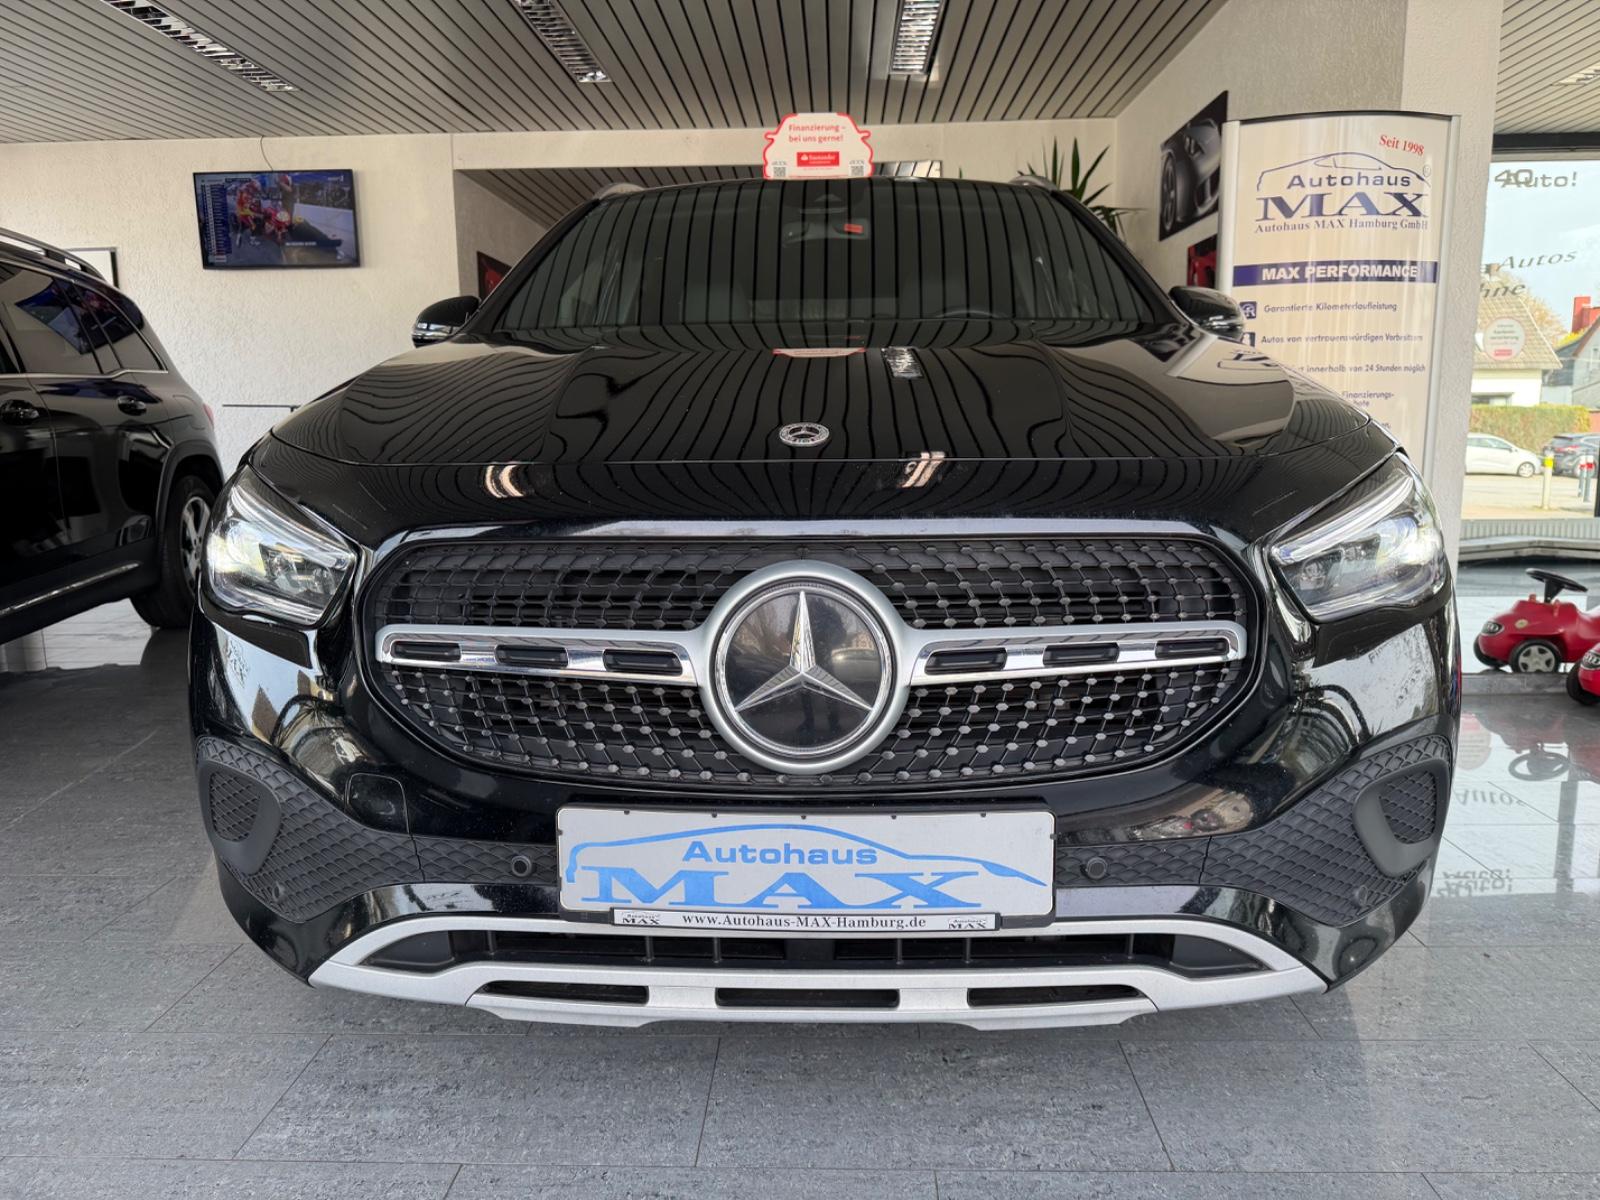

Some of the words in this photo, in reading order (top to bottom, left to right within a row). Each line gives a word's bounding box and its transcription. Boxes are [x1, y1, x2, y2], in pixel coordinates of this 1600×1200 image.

[788, 123, 840, 132] Finanzierung
[818, 135, 844, 144] gerne!
[1379, 134, 1400, 150] Seit
[1402, 140, 1425, 156] 1998
[1287, 172, 1412, 190] Autohaus
[1255, 192, 1429, 221] MAX
[1254, 222, 1310, 234] Autohaus
[1314, 219, 1346, 229] MAX
[1349, 218, 1398, 230] Hamburg
[1400, 218, 1429, 230] GmbH
[1496, 250, 1578, 272] Autos
[1262, 267, 1300, 281] MAX
[1305, 264, 1419, 279] PERFORMANCE
[1261, 335, 1284, 344] Autos
[1287, 335, 1302, 343] von
[1306, 363, 1346, 373] innerhalb
[1349, 364, 1363, 372] von
[1365, 363, 1374, 372] 24
[1375, 363, 1402, 373] Stunden
[682, 840, 879, 867] Autohaus
[581, 865, 982, 910] MAX
[682, 913, 927, 930] www.Autohaus-MAX-Hamburg.de
[948, 922, 987, 930] MAX
